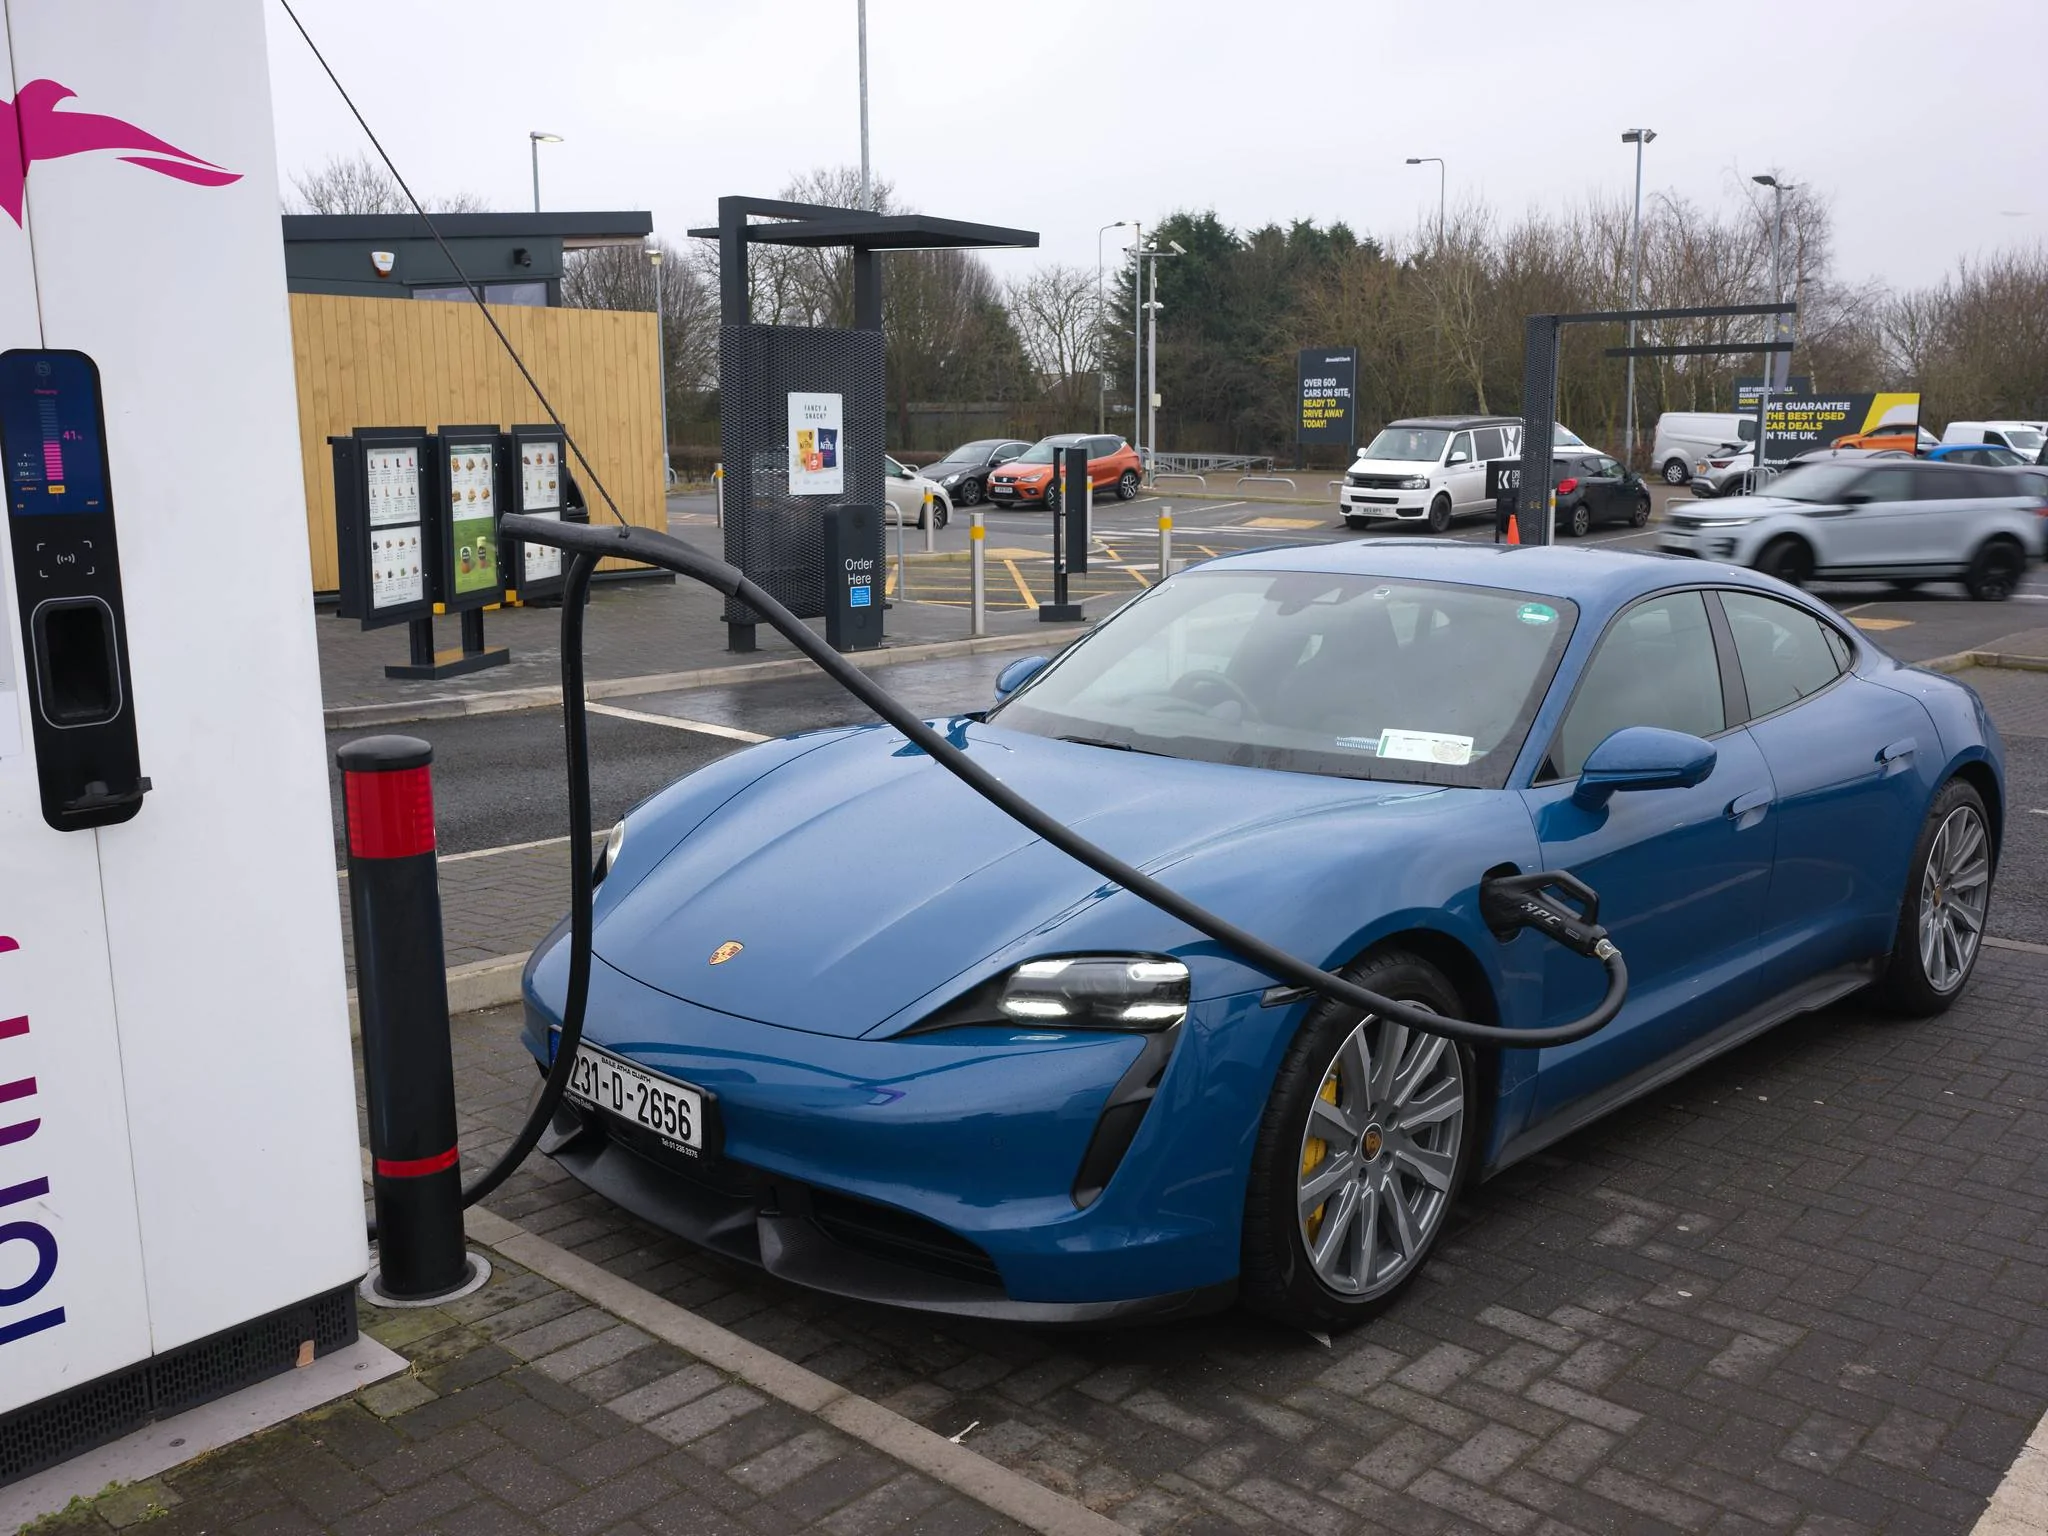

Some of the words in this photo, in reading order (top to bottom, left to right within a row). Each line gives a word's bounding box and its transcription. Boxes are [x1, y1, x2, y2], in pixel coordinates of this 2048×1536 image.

[1304, 378, 1322, 387] OVER
[1323, 378, 1336, 386] 600
[1304, 388, 1322, 398] CARS
[1322, 388, 1332, 398] ON
[1303, 399, 1326, 408] READY
[1326, 398, 1336, 408] TO
[1766, 402, 1783, 411] WE
[1785, 402, 1851, 411] GUARANTEE
[804, 404, 822, 412] FANCY
[823, 404, 828, 412] A
[805, 412, 827, 420] SNACK?
[1302, 410, 1323, 418] DRIVE
[1324, 409, 1344, 418] AWAY
[1766, 412, 1785, 421] THE
[1788, 412, 1815, 421] BEST
[1816, 412, 1846, 421] USED
[1302, 420, 1326, 428] TODAY!
[1765, 422, 1786, 430] CAR
[1788, 422, 1823, 430] DEALS
[1766, 431, 1775, 440] N
[1776, 431, 1798, 440] THE
[1799, 431, 1818, 440] UK.
[845, 557, 874, 571] Order
[847, 573, 872, 585] Here
